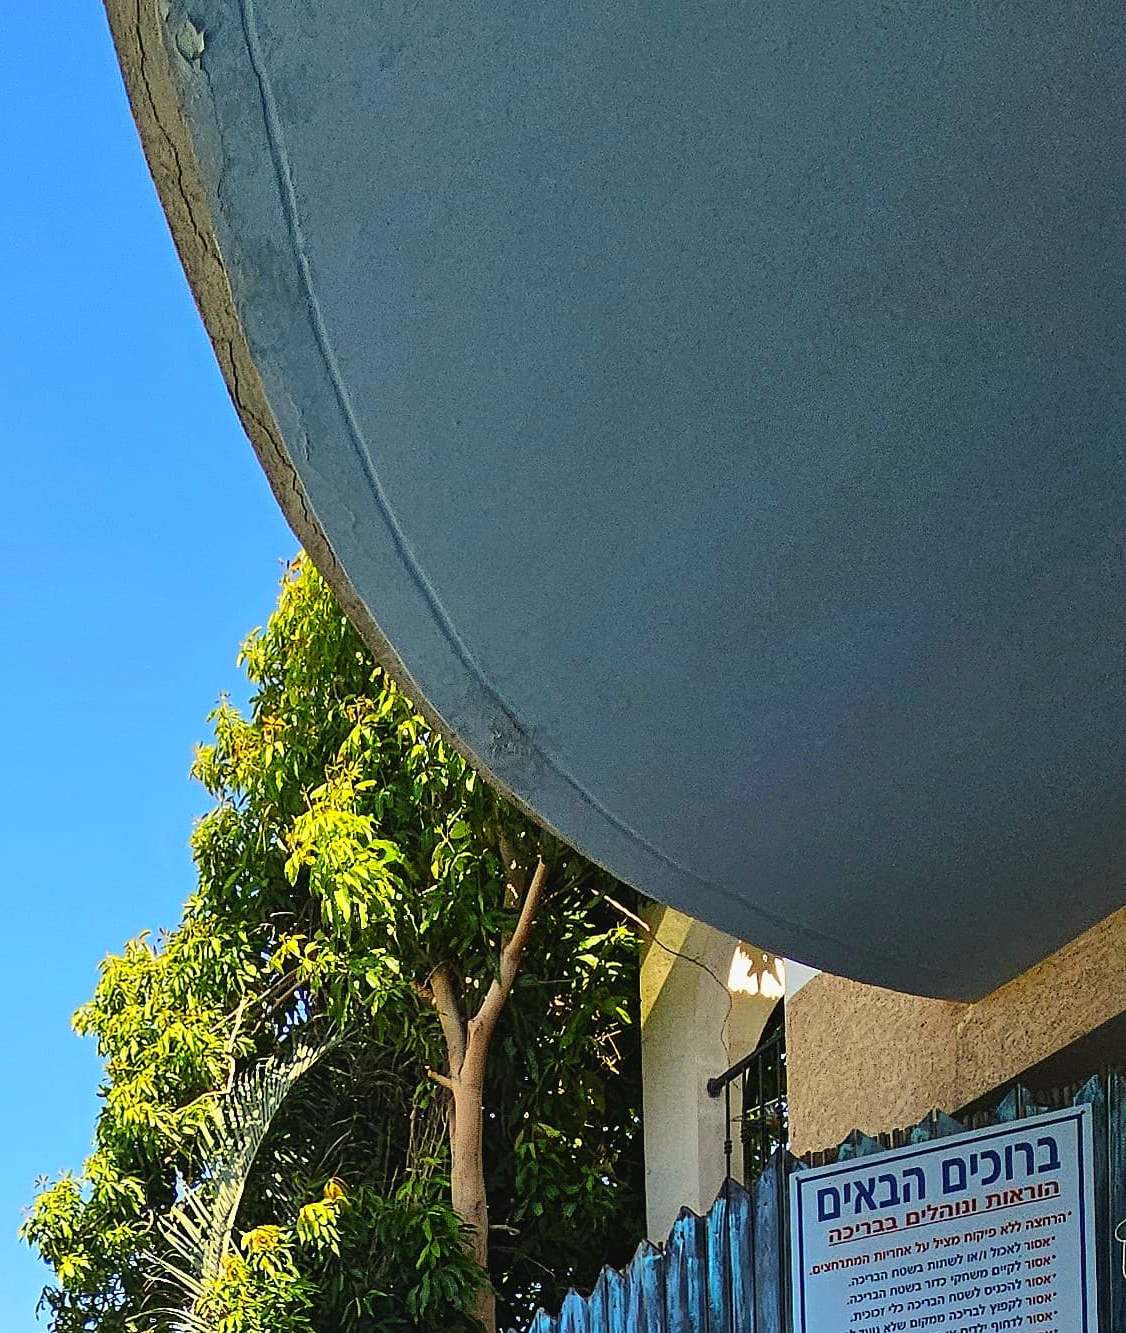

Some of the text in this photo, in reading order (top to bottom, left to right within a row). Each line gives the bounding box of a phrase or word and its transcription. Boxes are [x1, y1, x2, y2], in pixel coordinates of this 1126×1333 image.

[817, 1136, 1060, 1222] ברוכים הבאים
[828, 1180, 1059, 1242] הוראות ונוהלים בבריכה
[809, 1213, 1066, 1275] הרחצה ללא פיקוח מציל על אחריות המתרחצים.
[848, 1237, 1050, 1286] אסור לאכול ו/או לשתות בשטח הבריכה.
[991, 1260, 1021, 1276] לקיים
[1024, 1256, 1050, 1269] אסור
[950, 1268, 988, 1285] משחקי
[846, 1289, 886, 1304] הבריכה.
[889, 1282, 922, 1296] בשטח
[849, 1274, 1051, 1322] אסור להכניס לשטח הבריכה כלי זכוכית.
[989, 1296, 1022, 1315] לקפוץ
[1025, 1293, 1051, 1305] אסור
[948, 1303, 985, 1320] לבריכה
[1026, 1311, 1052, 1324] אסור
[883, 1321, 906, 1333] שלא
[909, 1313, 945, 1328] ממקום
[990, 1314, 1023, 1332] לדחוף
